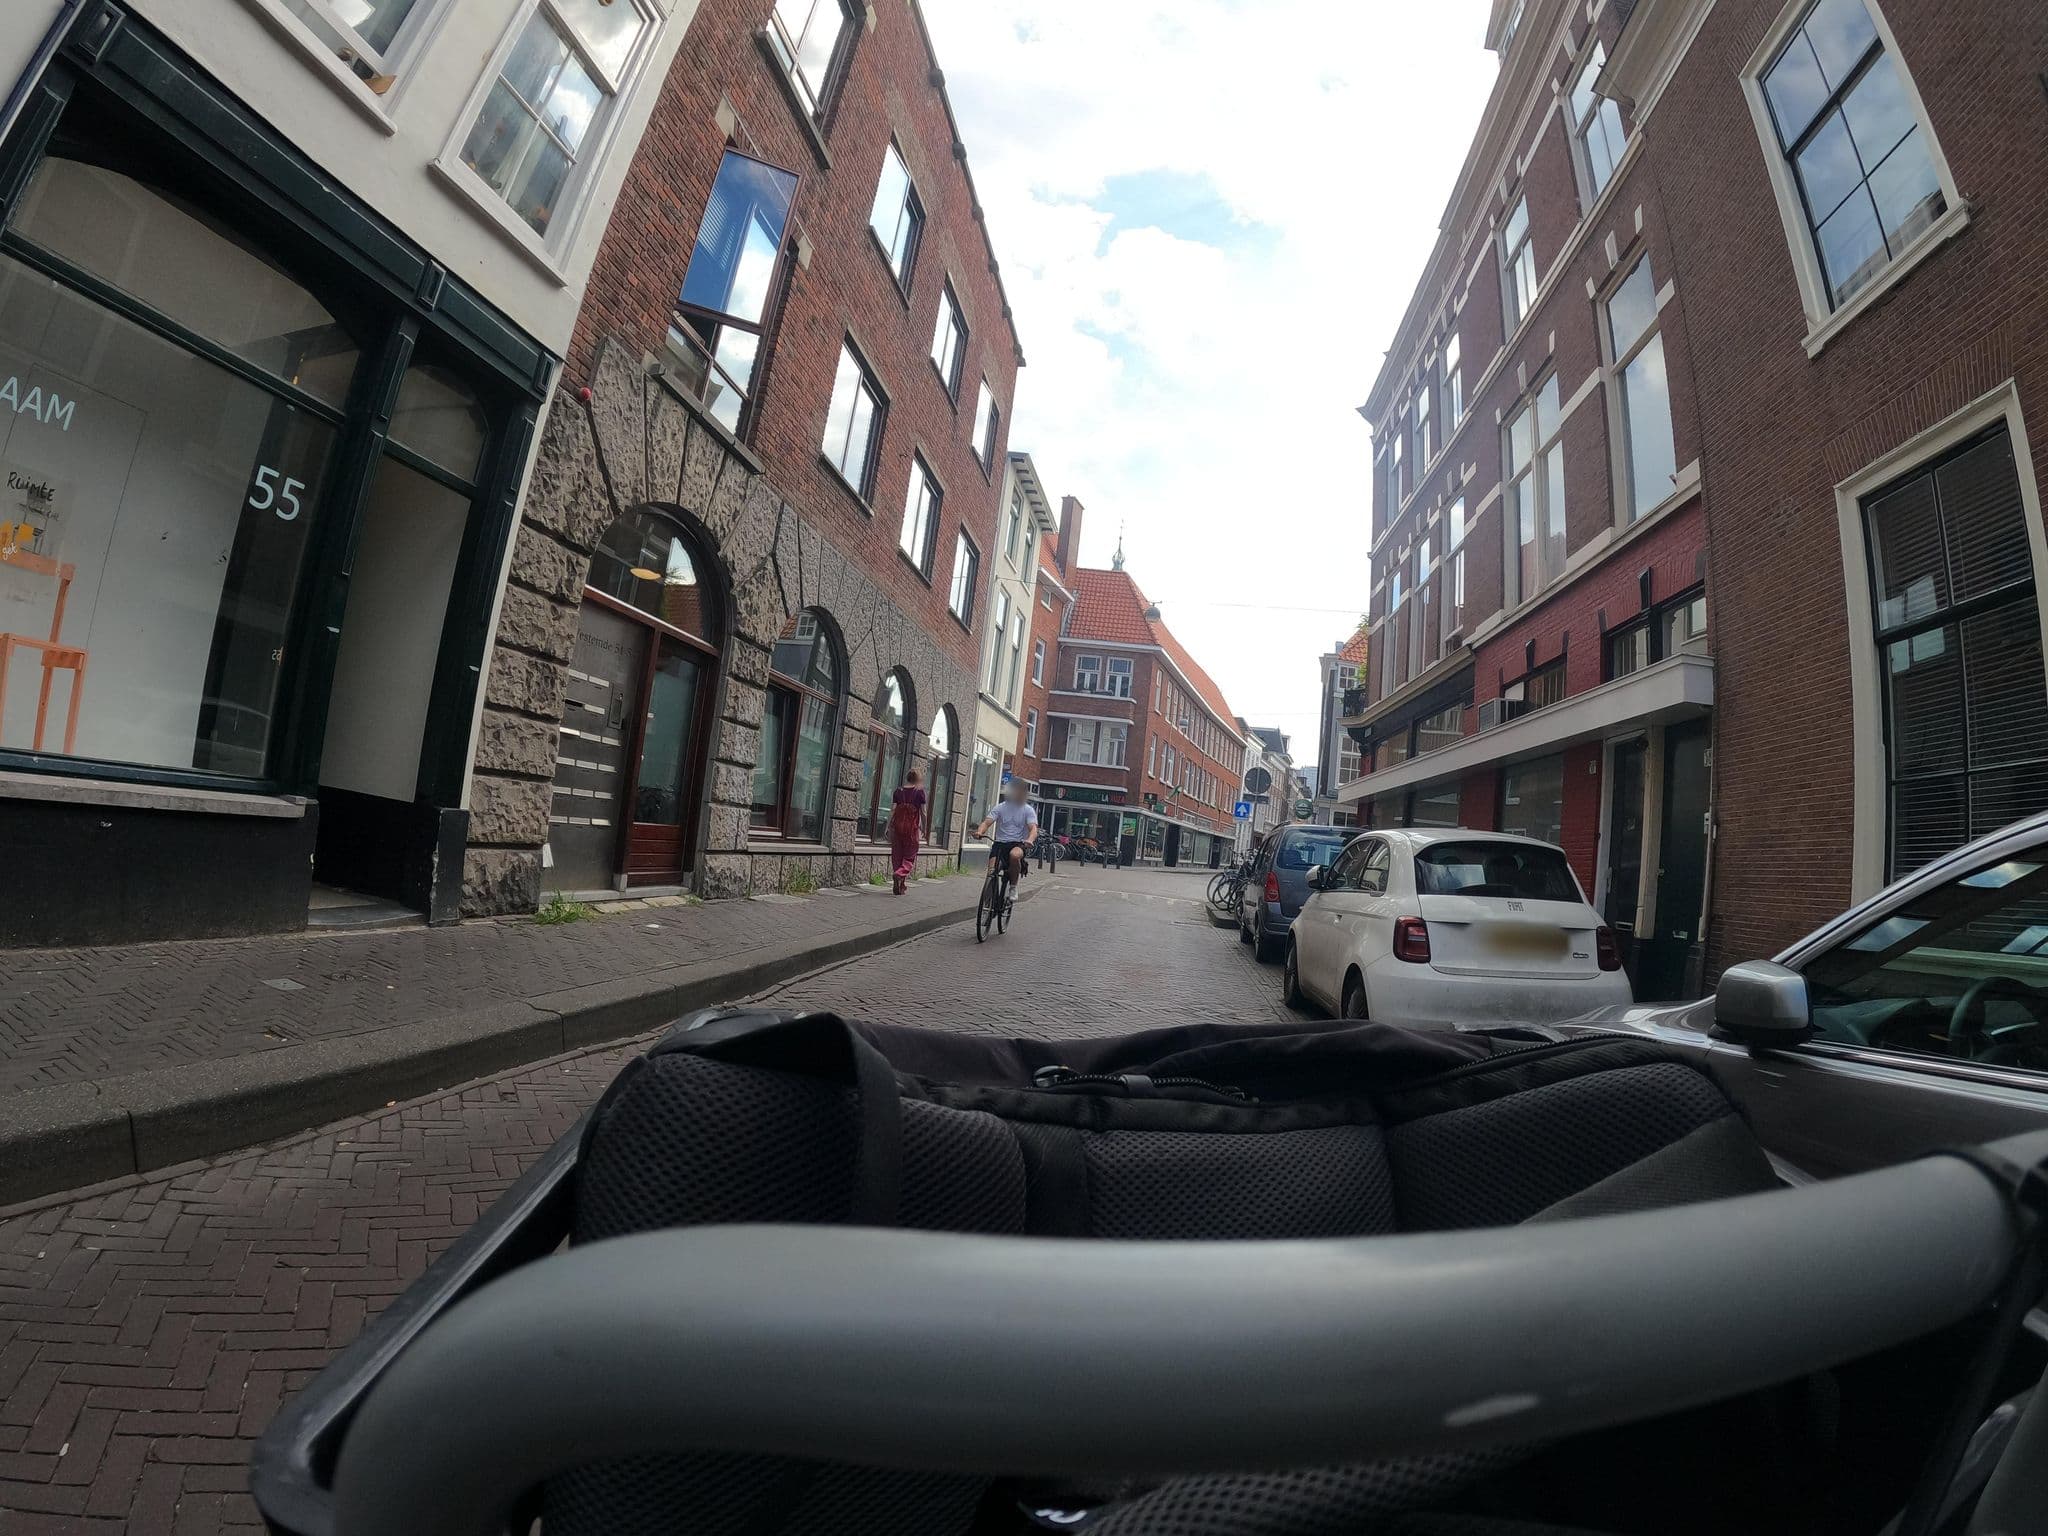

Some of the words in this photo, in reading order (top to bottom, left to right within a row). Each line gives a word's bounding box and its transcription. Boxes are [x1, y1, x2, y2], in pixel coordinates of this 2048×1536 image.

[0, 376, 75, 432] AAM
[249, 465, 306, 521] 55
[577, 629, 613, 651] esteinde
[1507, 901, 1524, 911] FIAT
